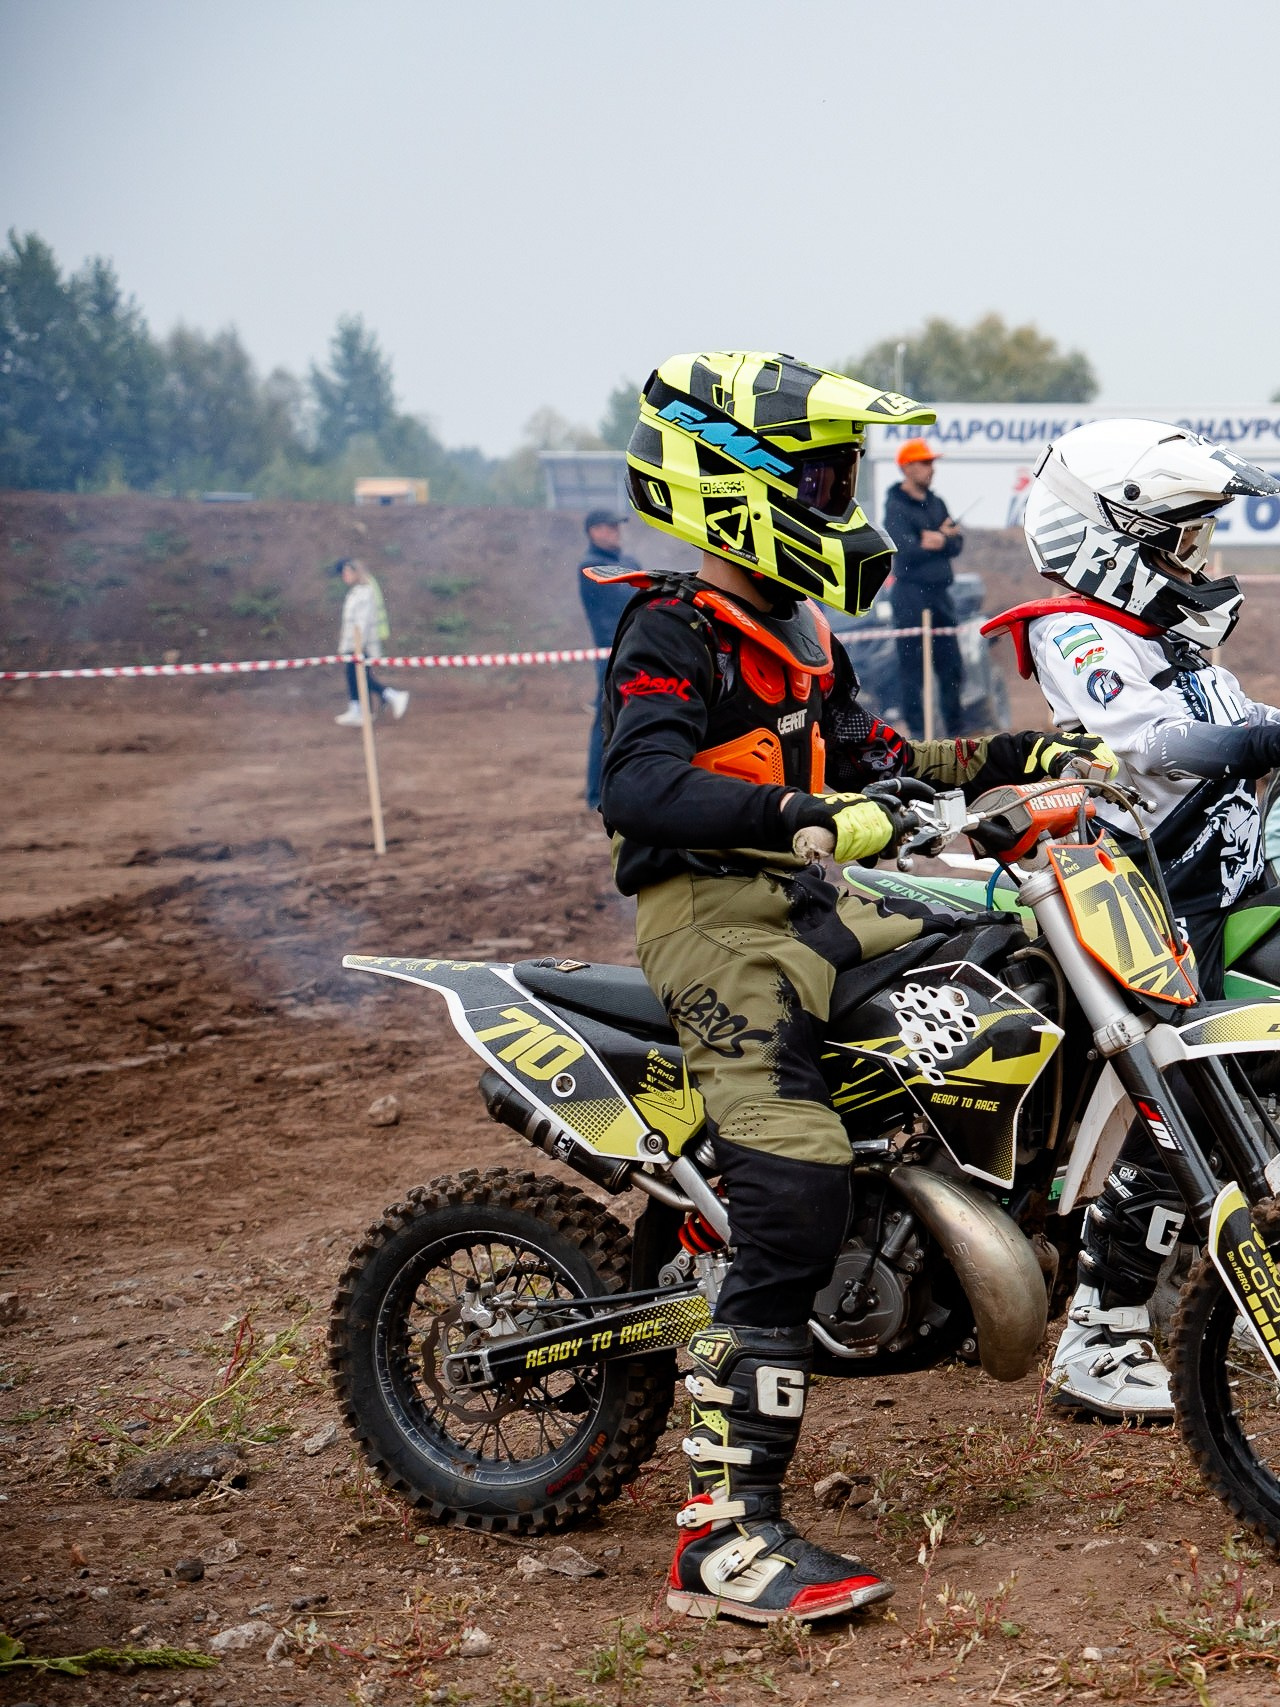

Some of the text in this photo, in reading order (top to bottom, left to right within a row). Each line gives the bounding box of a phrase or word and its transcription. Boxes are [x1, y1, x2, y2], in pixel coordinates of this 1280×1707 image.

[656, 400, 795, 476] FMF
[1063, 527, 1169, 616] FLY
[876, 879, 950, 907] DUNL
[1074, 870, 1172, 974] 710
[475, 1006, 585, 1081] 710
[930, 1092, 1000, 1112] READY TO RACE
[525, 1317, 666, 1369] READY TO RACE
[755, 1366, 804, 1418] G
